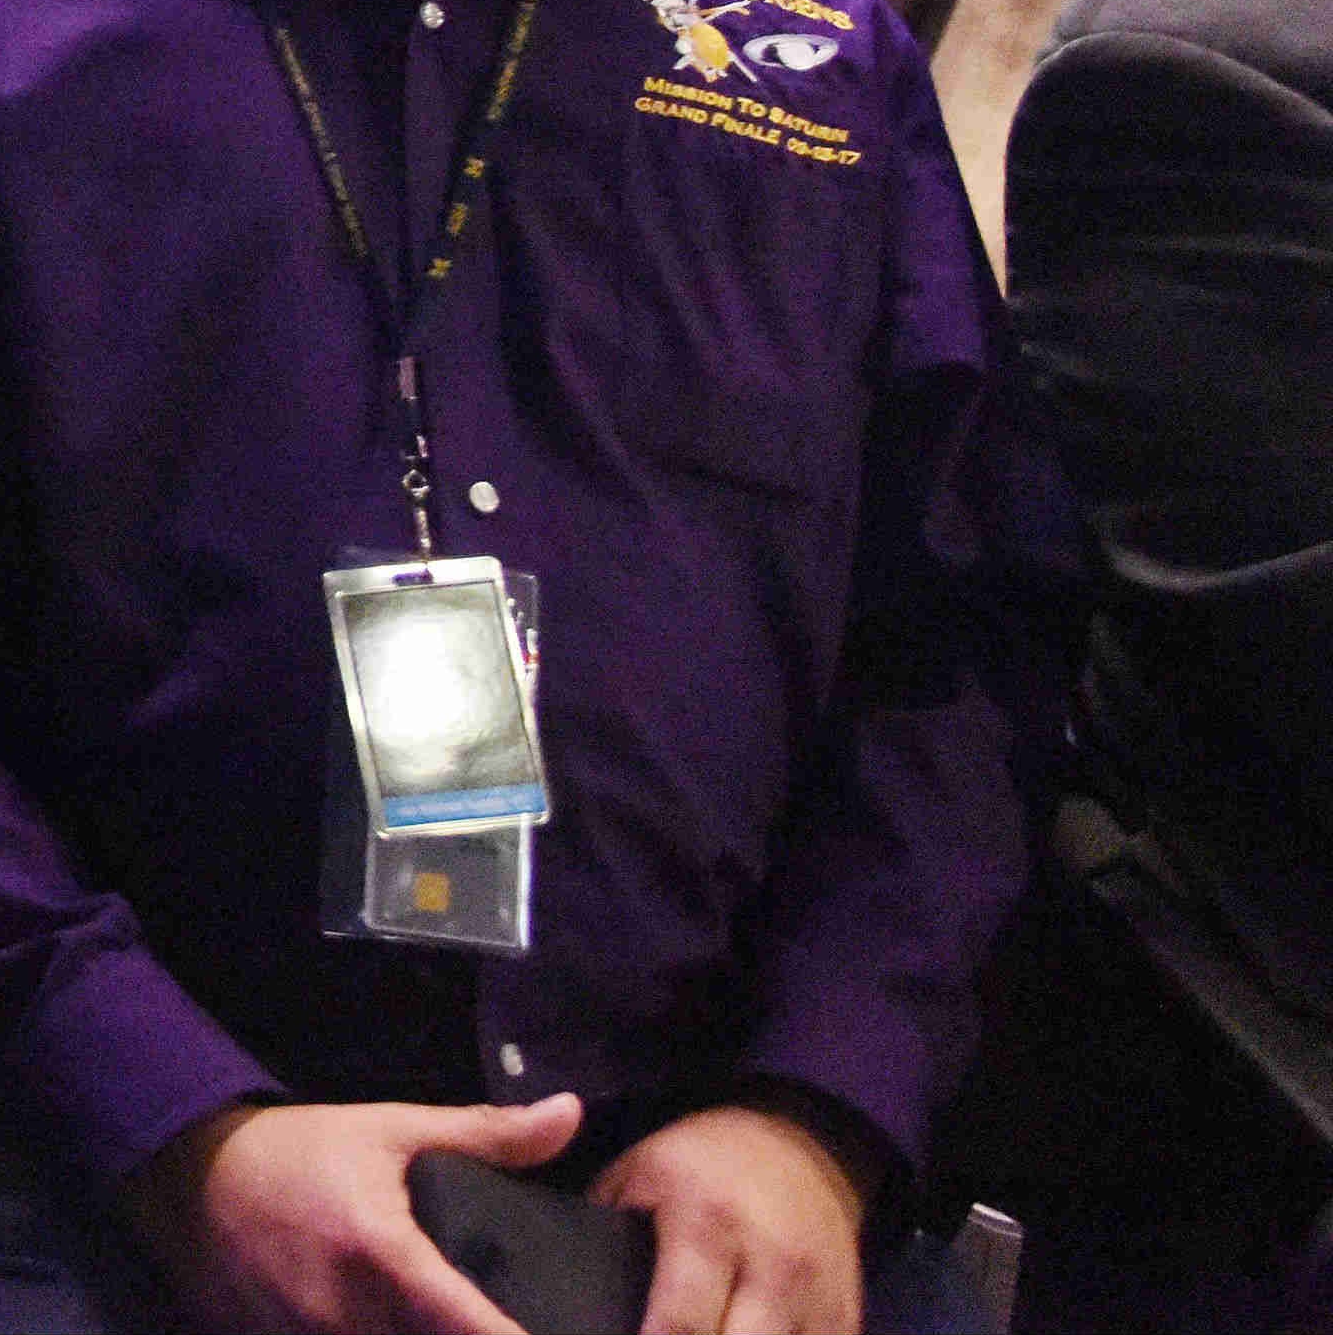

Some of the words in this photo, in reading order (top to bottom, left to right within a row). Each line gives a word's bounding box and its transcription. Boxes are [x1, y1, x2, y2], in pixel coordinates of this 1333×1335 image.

[634, 96, 709, 124] GRAND
[710, 112, 782, 145] FINALE
[644, 76, 733, 111] MISSION
[737, 97, 768, 119] TO
[769, 107, 850, 143] SATURN
